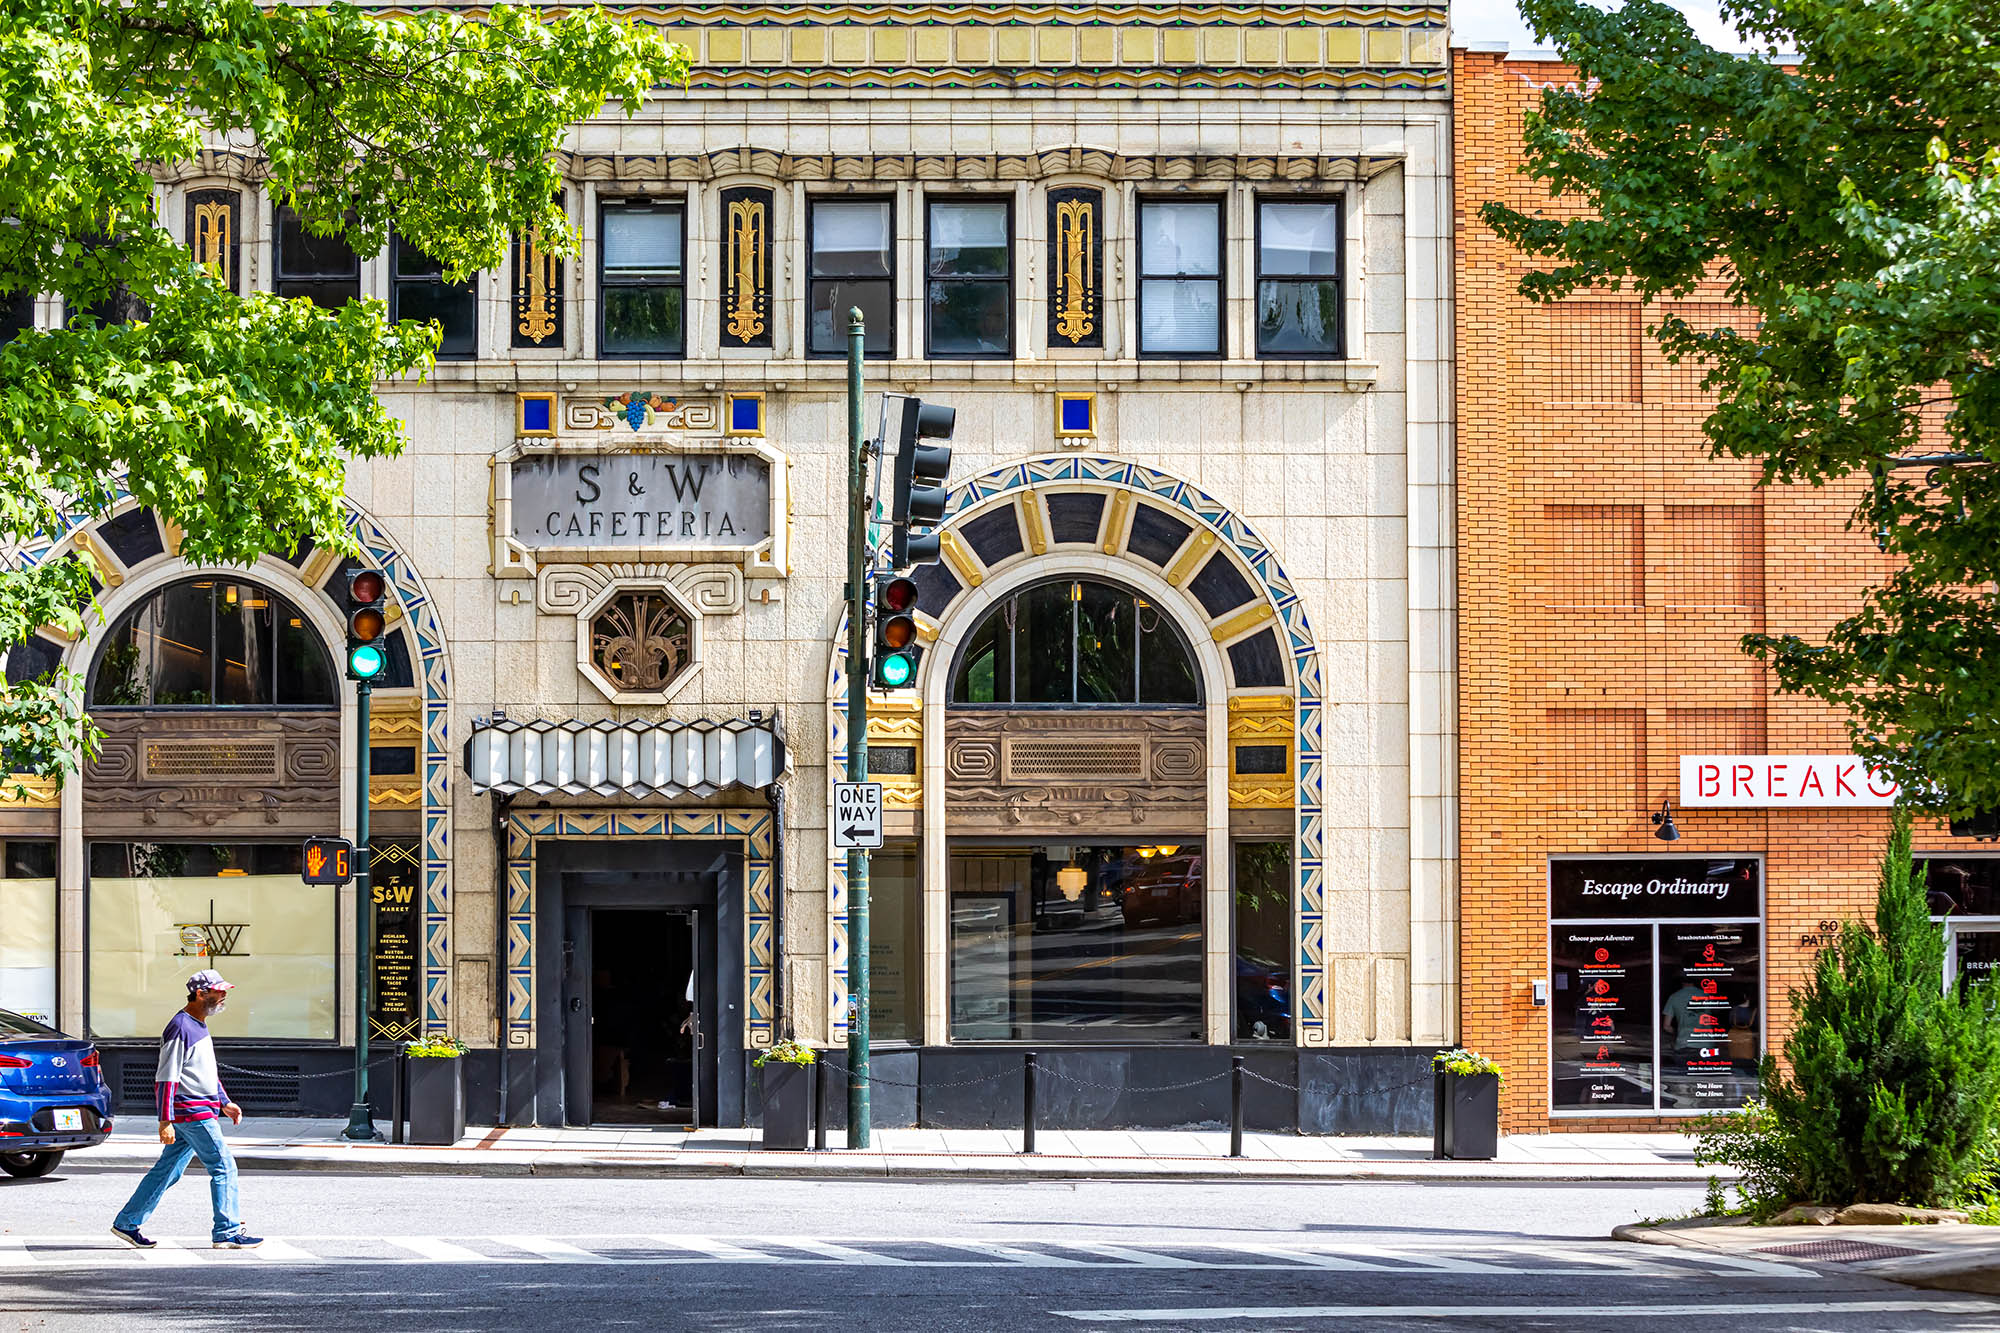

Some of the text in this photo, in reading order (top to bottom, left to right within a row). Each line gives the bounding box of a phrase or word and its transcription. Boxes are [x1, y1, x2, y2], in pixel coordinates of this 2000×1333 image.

[576, 464, 710, 505] S & W
[546, 511, 737, 538] CAFETERIA
[1698, 764, 1898, 798] BREAKO
[840, 788, 876, 803] ONE
[839, 806, 877, 821] WAY
[336, 849, 348, 877] 6
[372, 886, 414, 903] S&W
[1582, 878, 1730, 900] Escape Ordinary
[1820, 920, 1838, 931] 60
[1801, 934, 1847, 946] PATTO
